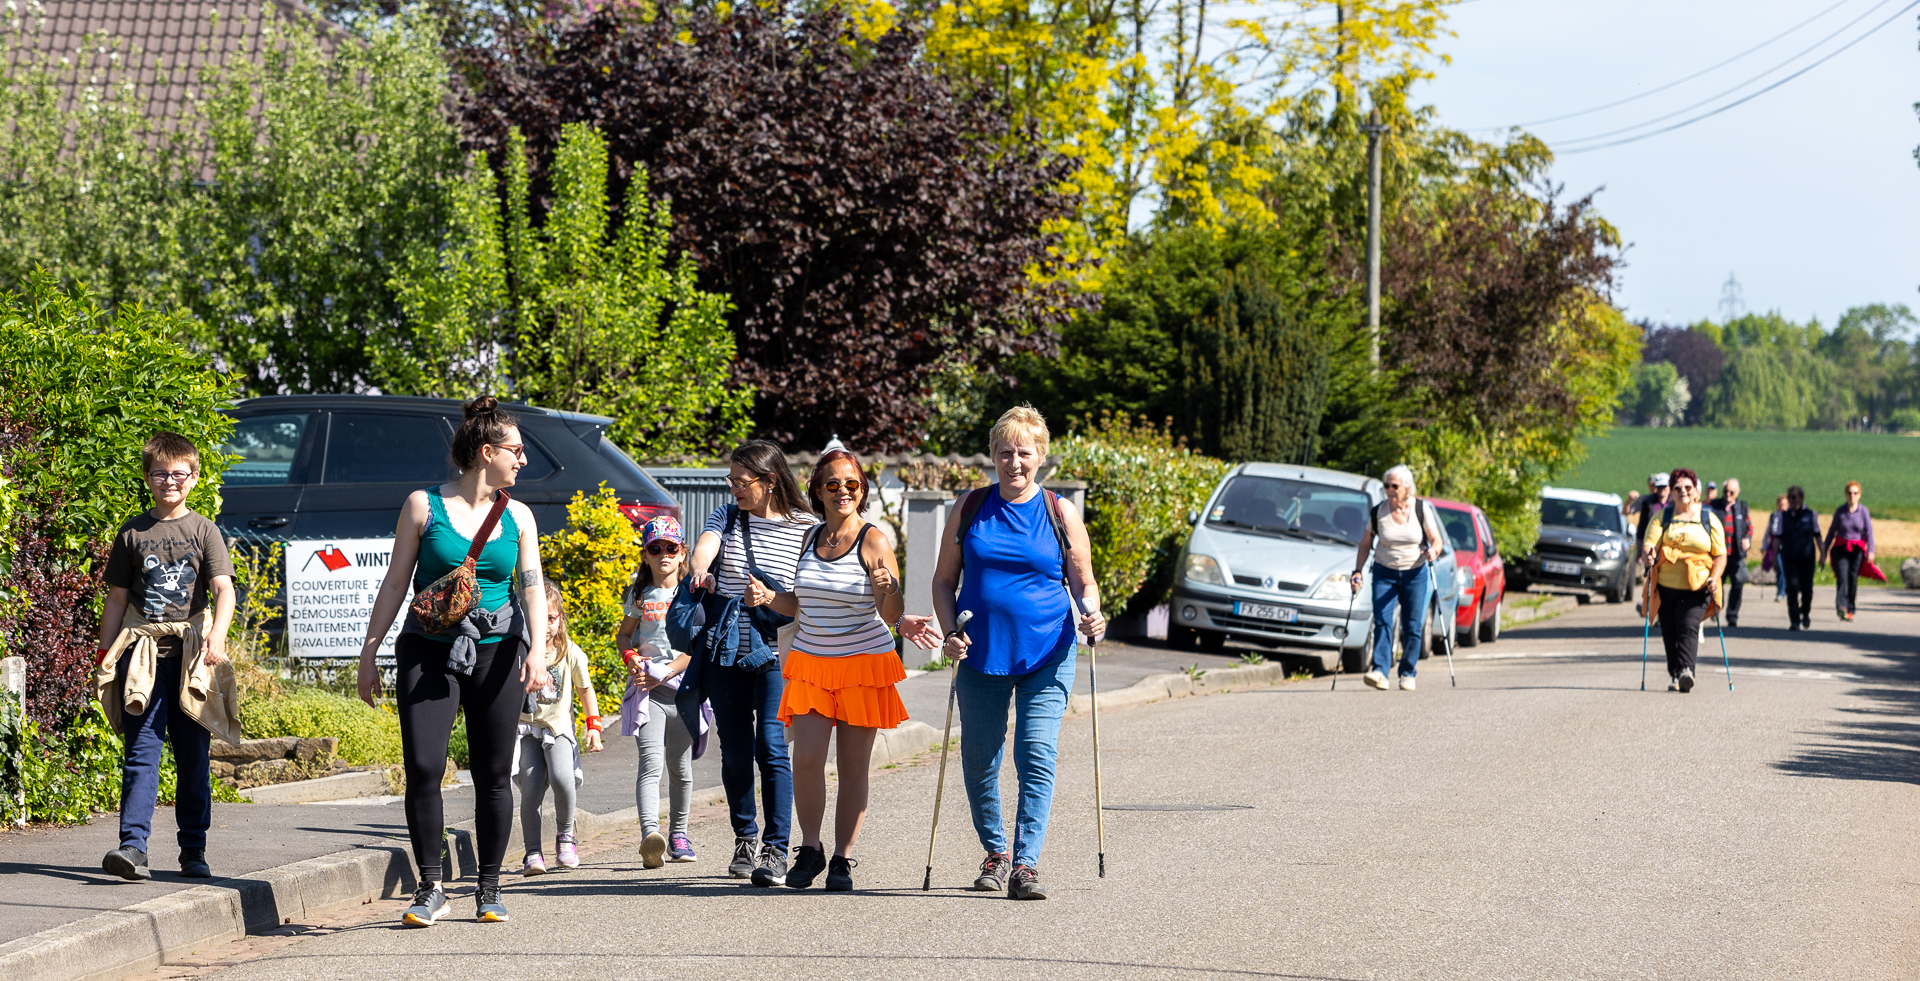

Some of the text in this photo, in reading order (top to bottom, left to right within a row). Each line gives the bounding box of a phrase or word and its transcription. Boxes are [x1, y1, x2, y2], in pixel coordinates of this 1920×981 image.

[355, 552, 391, 567] WINT
[292, 580, 369, 591] COUVERTURE
[292, 592, 361, 605] ETANCHEITÉ
[644, 602, 671, 611] mor
[293, 608, 373, 619] DÉMOUSSAGE
[293, 622, 361, 633] TRAITEMENT
